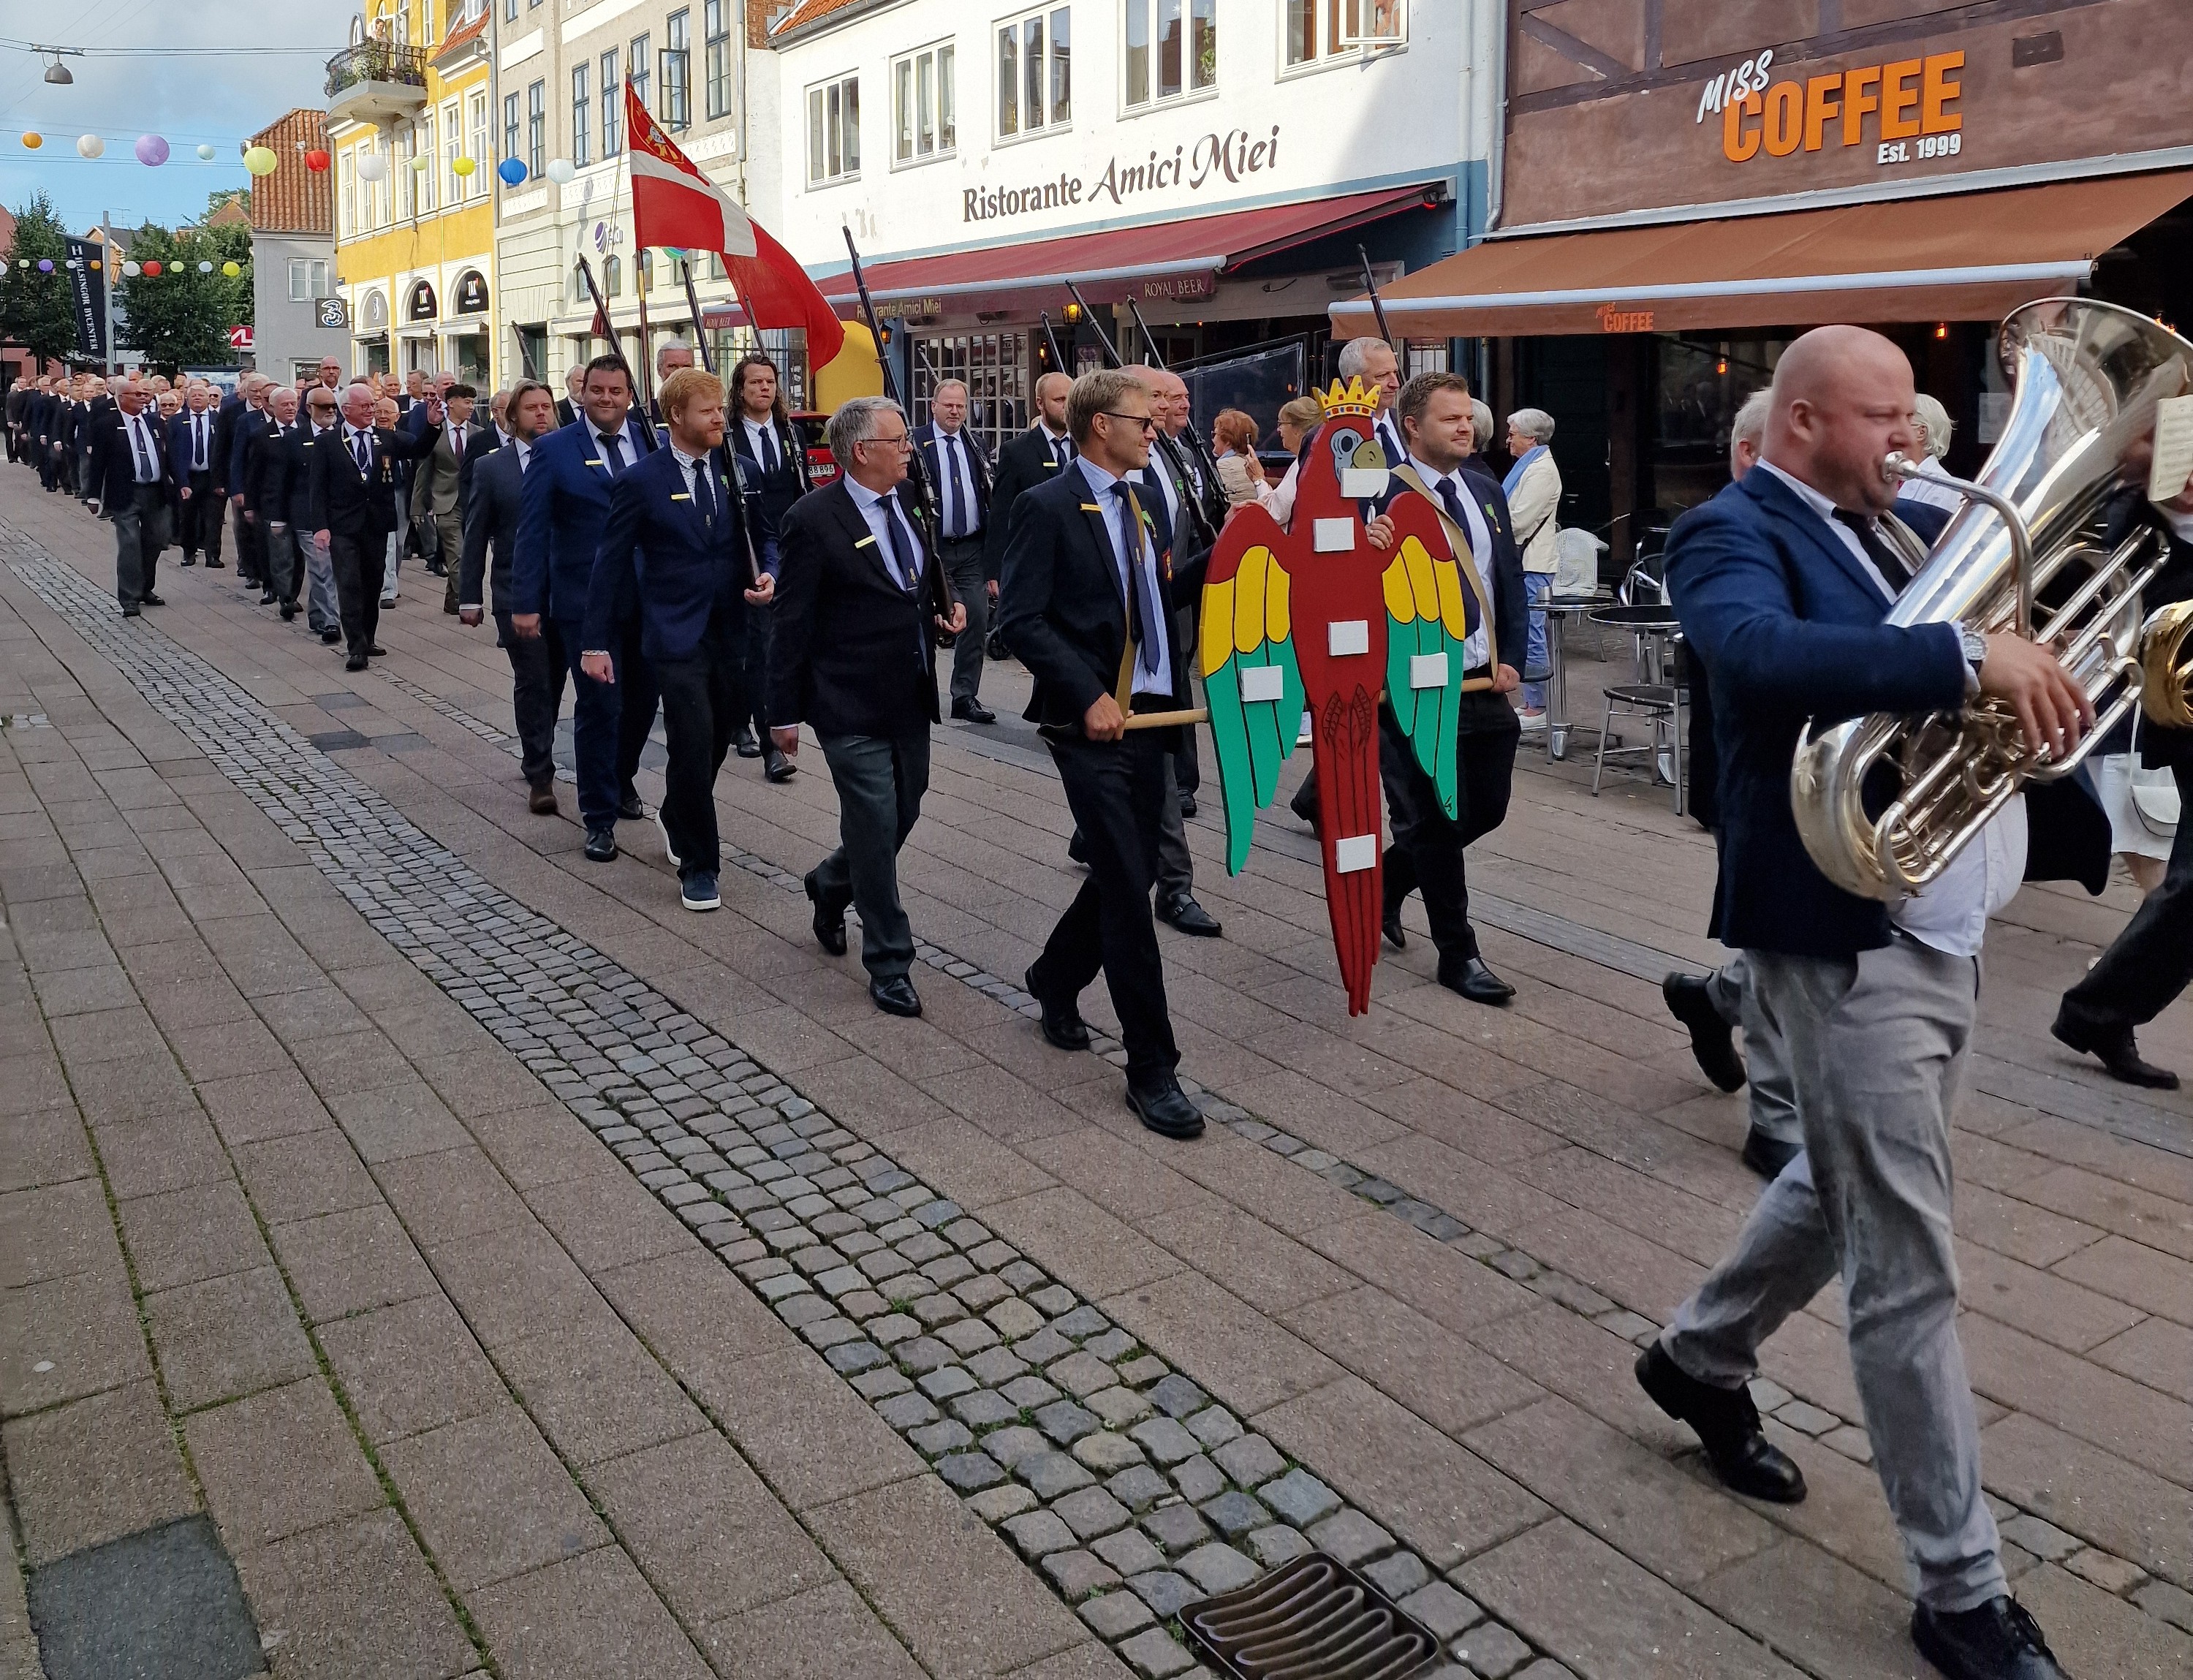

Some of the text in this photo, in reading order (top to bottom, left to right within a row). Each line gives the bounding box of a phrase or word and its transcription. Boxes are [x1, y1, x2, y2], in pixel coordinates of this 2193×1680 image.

[1696, 49, 1773, 124] MISS
[1723, 50, 1965, 162] COFFEE
[1876, 133, 1962, 165] Est. 1999
[963, 124, 1279, 222] Ristorante Amici Miei
[1144, 279, 1205, 298] ROYAL BEER
[923, 297, 942, 314] Miei
[1603, 311, 1655, 332] COFFEE
